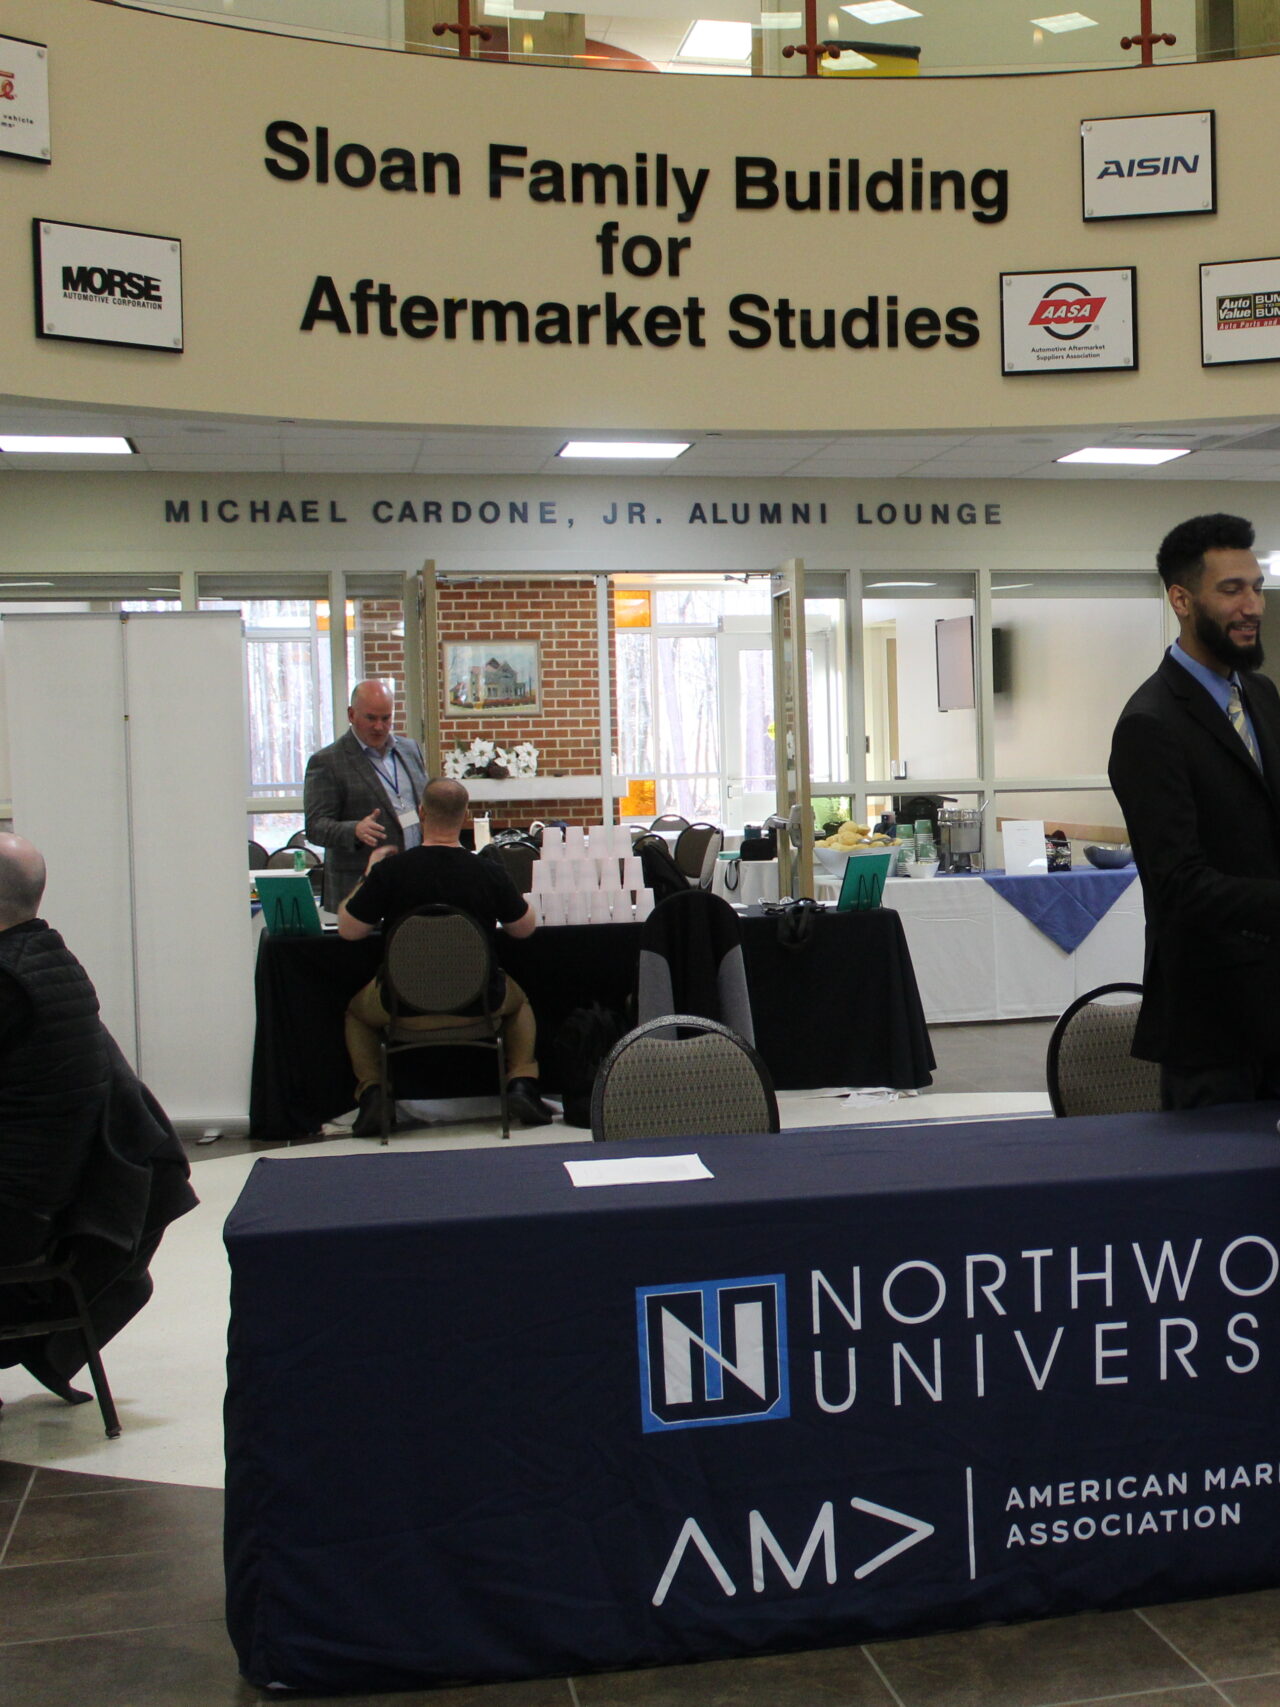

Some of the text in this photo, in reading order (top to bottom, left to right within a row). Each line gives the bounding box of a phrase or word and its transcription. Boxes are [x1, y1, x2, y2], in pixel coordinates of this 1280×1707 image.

[264, 120, 1009, 224] Sloan Family Building
[1096, 154, 1200, 180] AISIN
[596, 221, 691, 277] for
[62, 266, 162, 302] MORSE
[63, 291, 162, 310] AUTOMOTIVE CORPORATION
[300, 275, 980, 348] Aftermarket Studies
[1040, 304, 1092, 319] AASA
[1221, 297, 1250, 309] Auto
[1219, 309, 1252, 320] Value
[1031, 345, 1067, 353] Automotive
[1065, 352, 1100, 360] Association
[165, 500, 1002, 528] MICHAEL CARDONE, JR. ALUMNI LOUNGE
[1005, 1472, 1187, 1511] AMERICAN
[1006, 1502, 1241, 1548] ASSOCIATION
